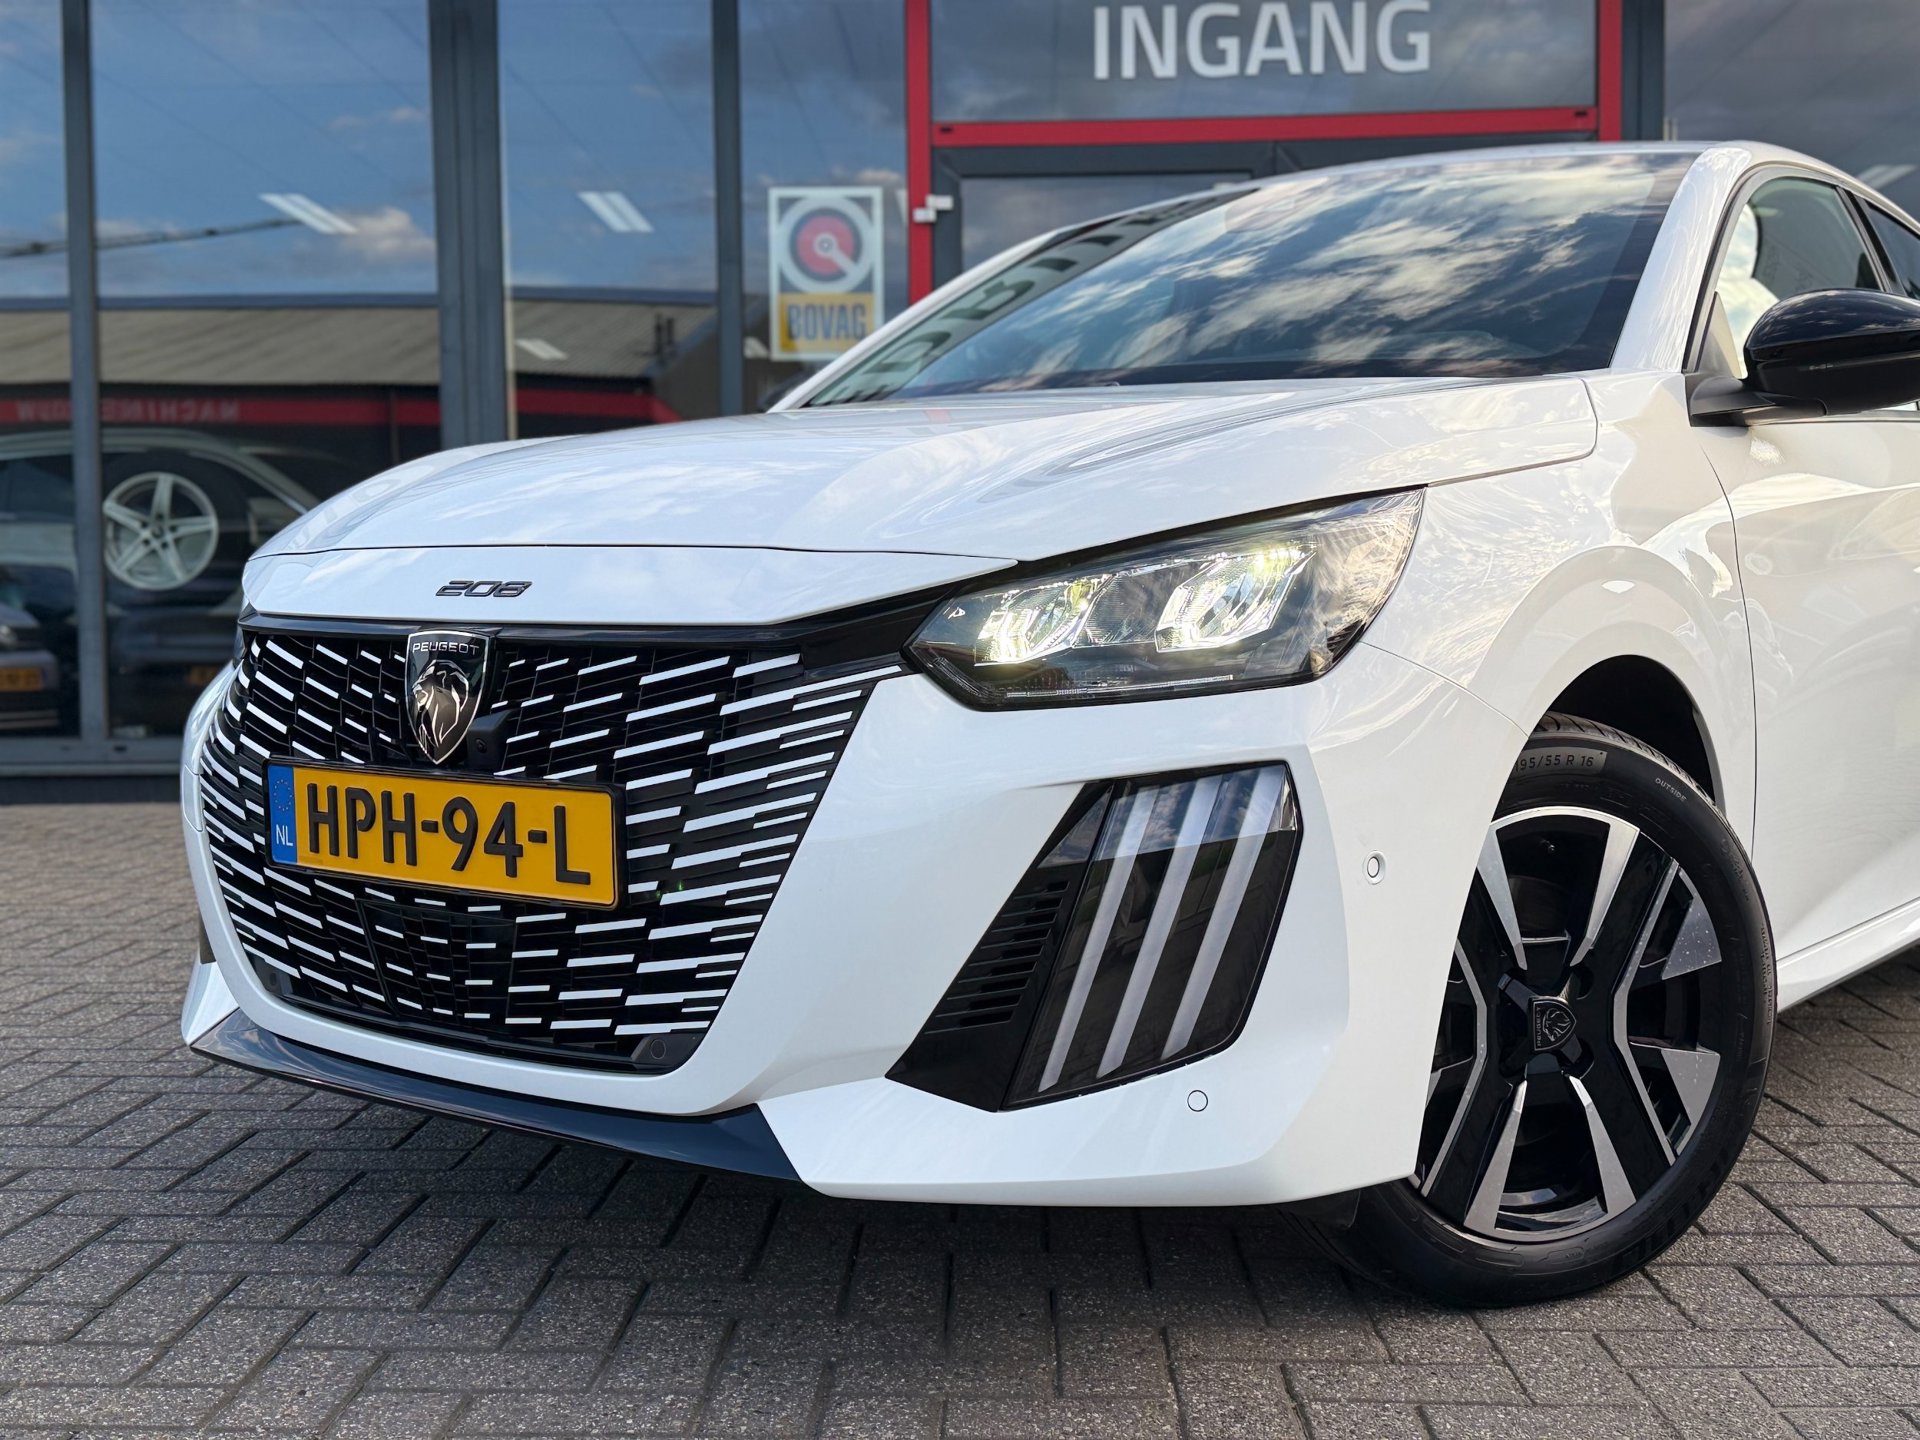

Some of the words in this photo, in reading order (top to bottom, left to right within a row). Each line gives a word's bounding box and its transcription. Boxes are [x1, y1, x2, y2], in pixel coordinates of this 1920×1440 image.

[1093, 0, 1432, 80] INGANG
[787, 303, 866, 340] BOVAG
[434, 580, 533, 598] 208
[412, 641, 480, 655] PEUGEOT
[1566, 754, 1575, 767] R
[1581, 755, 1594, 767] 16
[1655, 777, 1687, 802] OUTSIDE
[275, 824, 294, 847] NL
[306, 783, 591, 886] HPH-94-L
